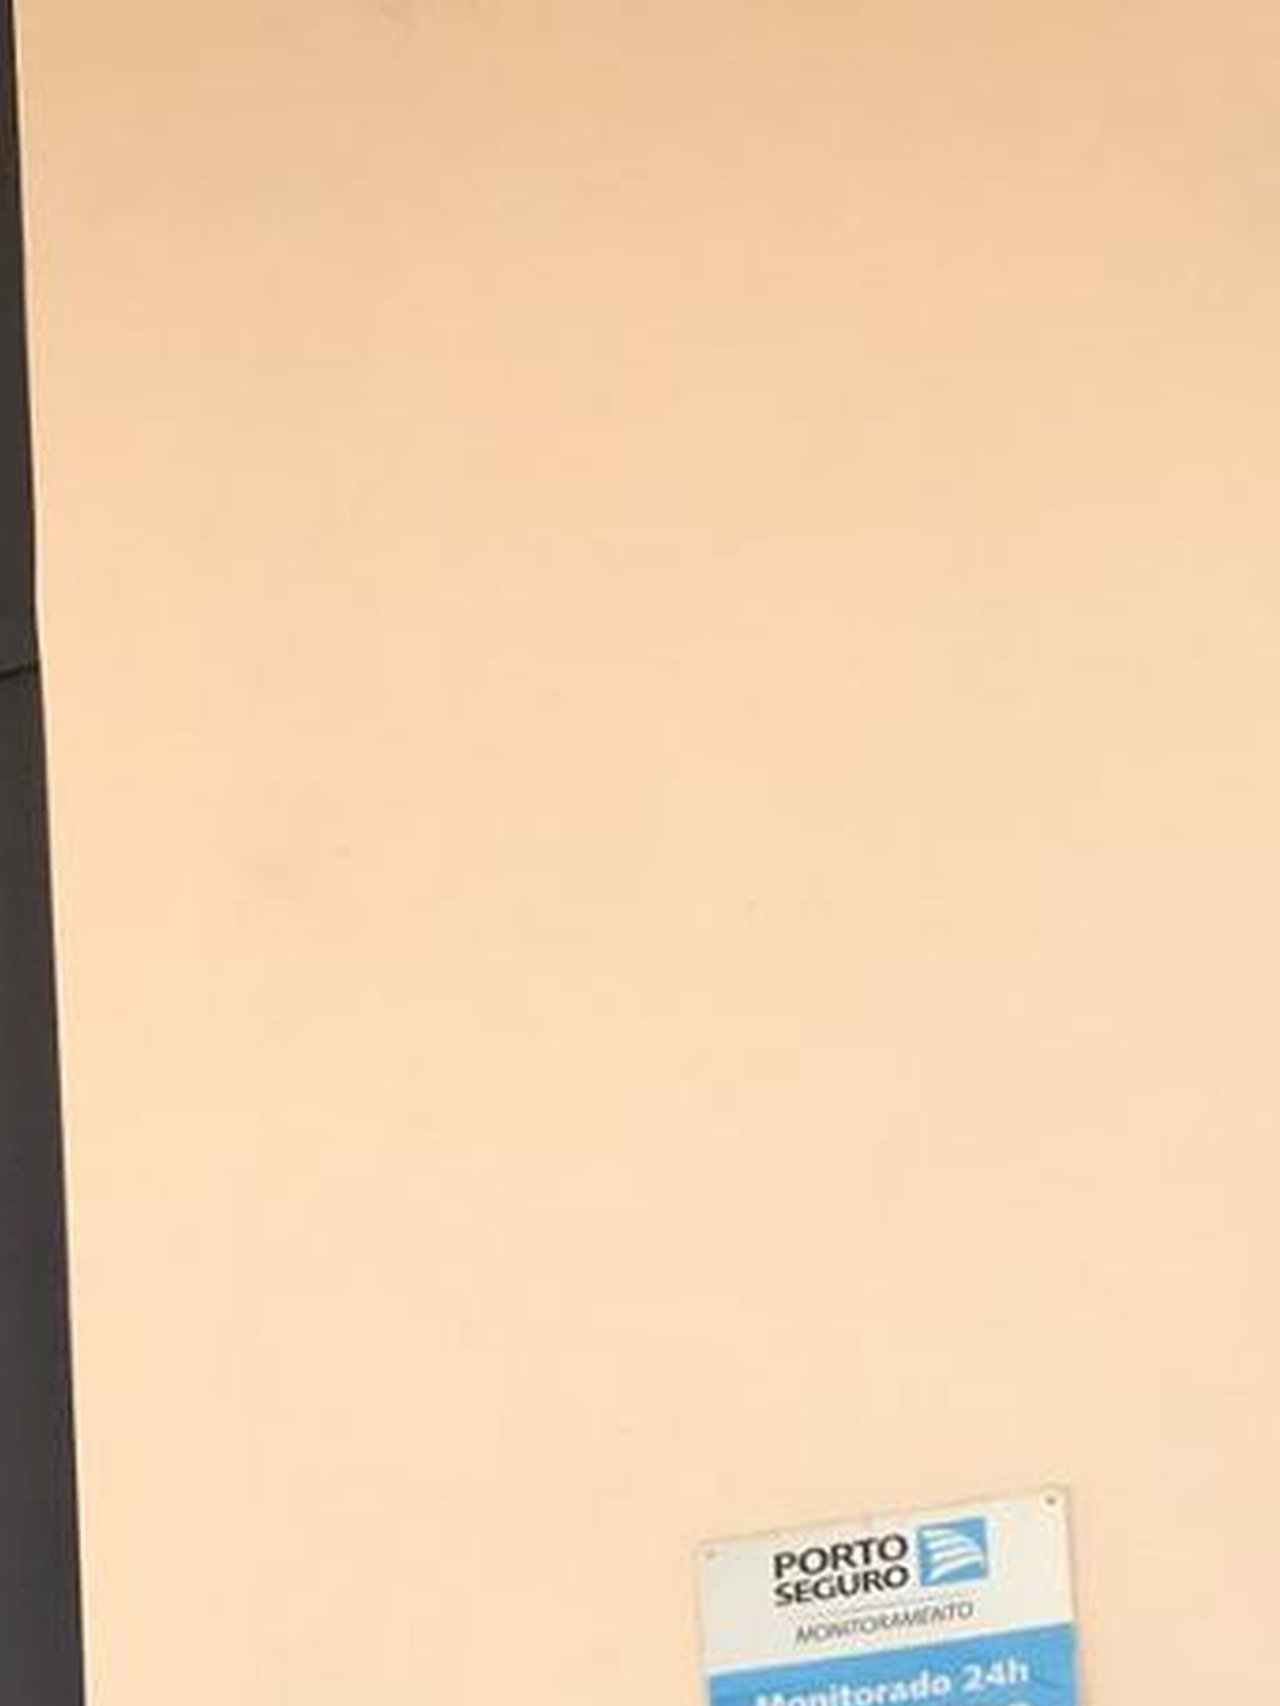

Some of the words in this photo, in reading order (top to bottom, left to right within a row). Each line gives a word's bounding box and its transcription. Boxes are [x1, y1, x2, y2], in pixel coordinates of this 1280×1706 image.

[772, 1534, 911, 1580] PORTO
[774, 1565, 911, 1607] SEGURO
[795, 1601, 975, 1644] MONITORAMENTO
[961, 1657, 1030, 1692] 24h
